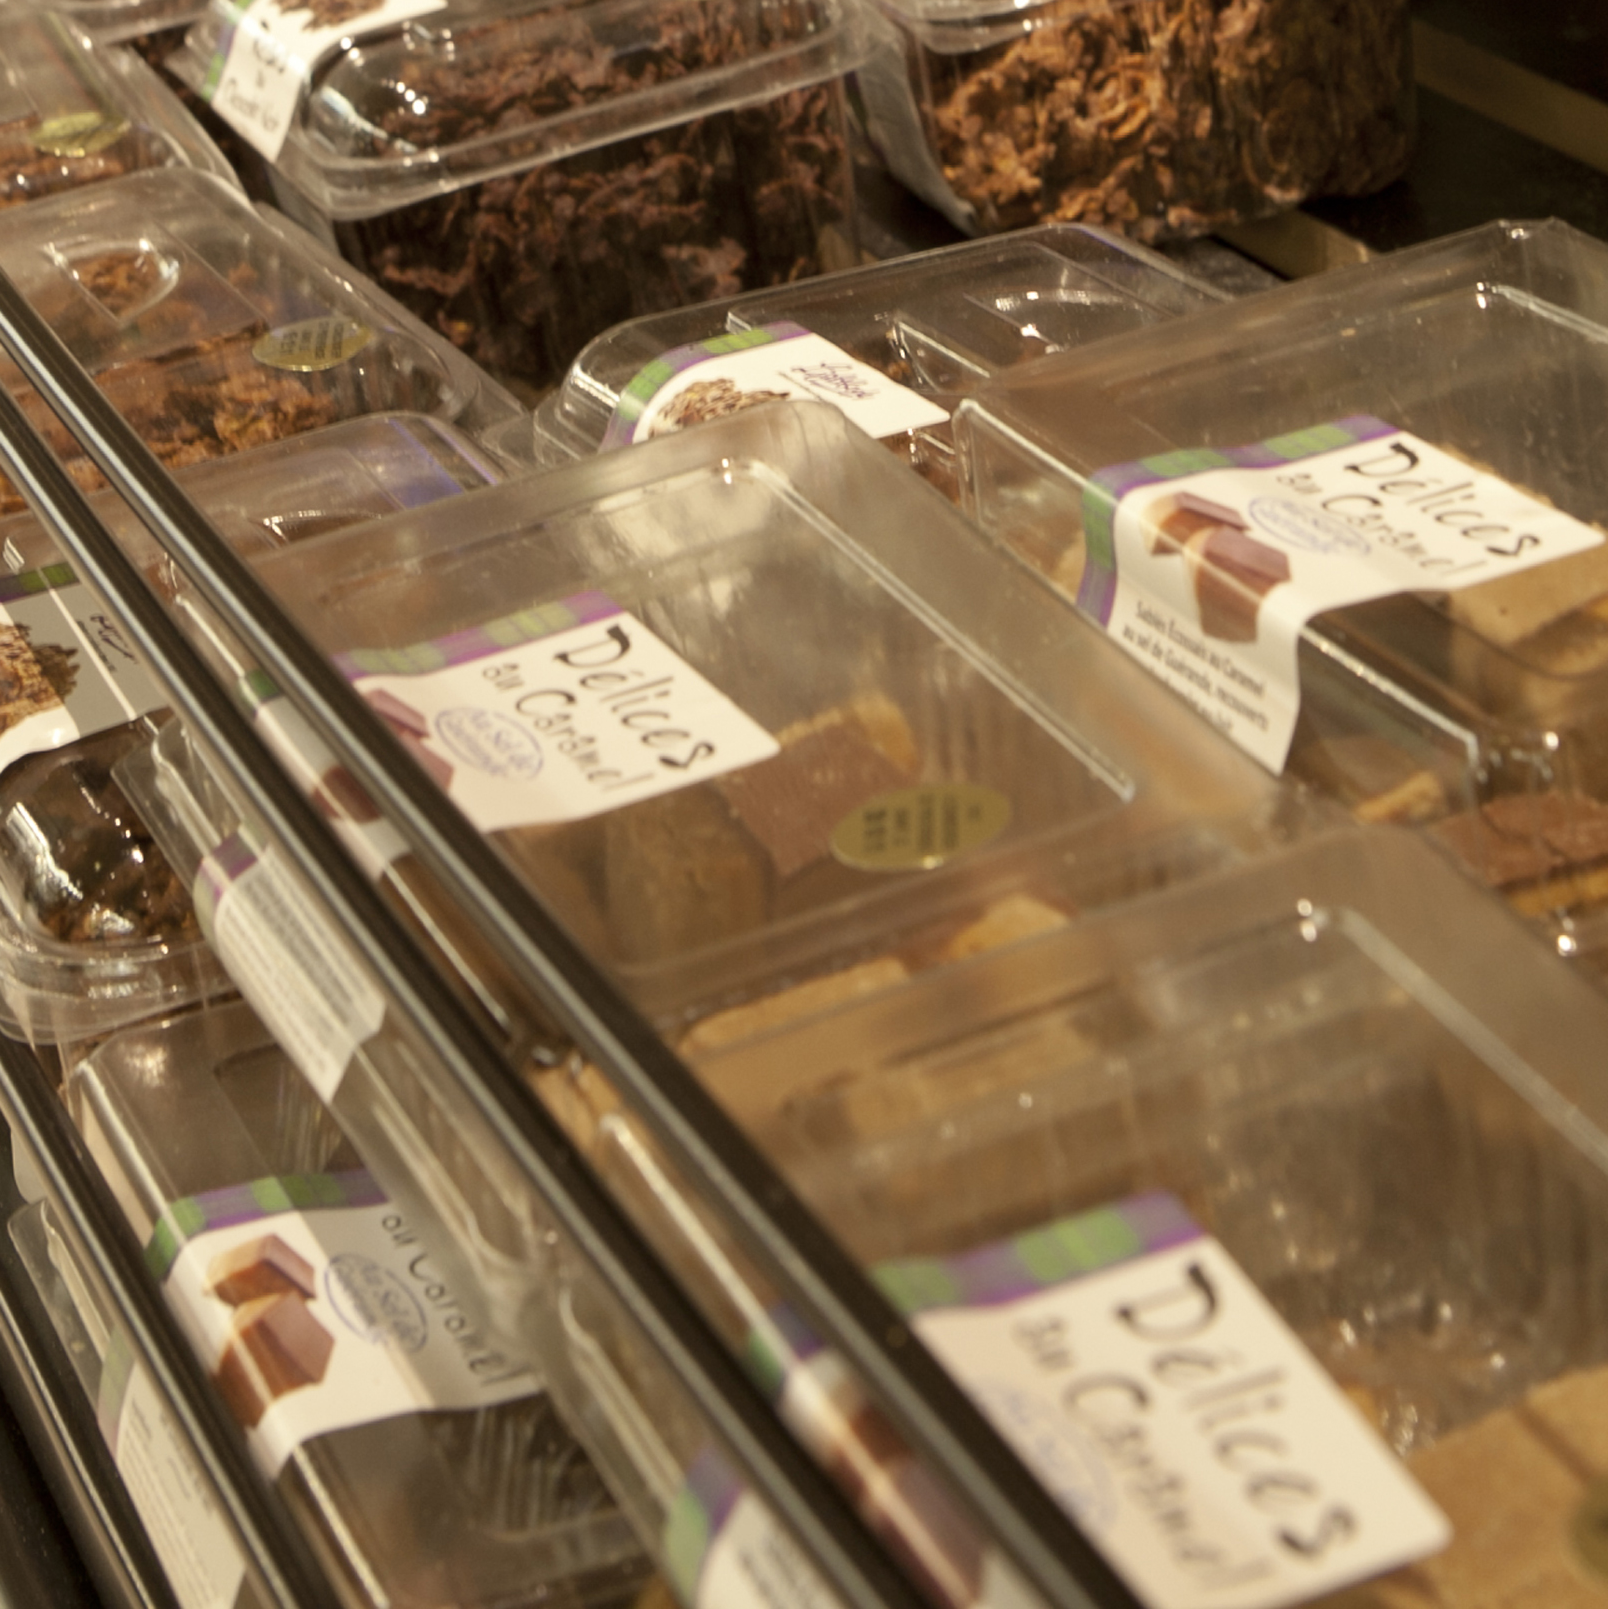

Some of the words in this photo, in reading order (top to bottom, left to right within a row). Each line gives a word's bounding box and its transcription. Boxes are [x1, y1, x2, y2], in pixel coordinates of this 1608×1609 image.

[1344, 442, 1541, 558] Délices
[514, 688, 656, 792] Caramel
[551, 623, 718, 770] Délices
[1112, 1260, 1359, 1563] Délices
